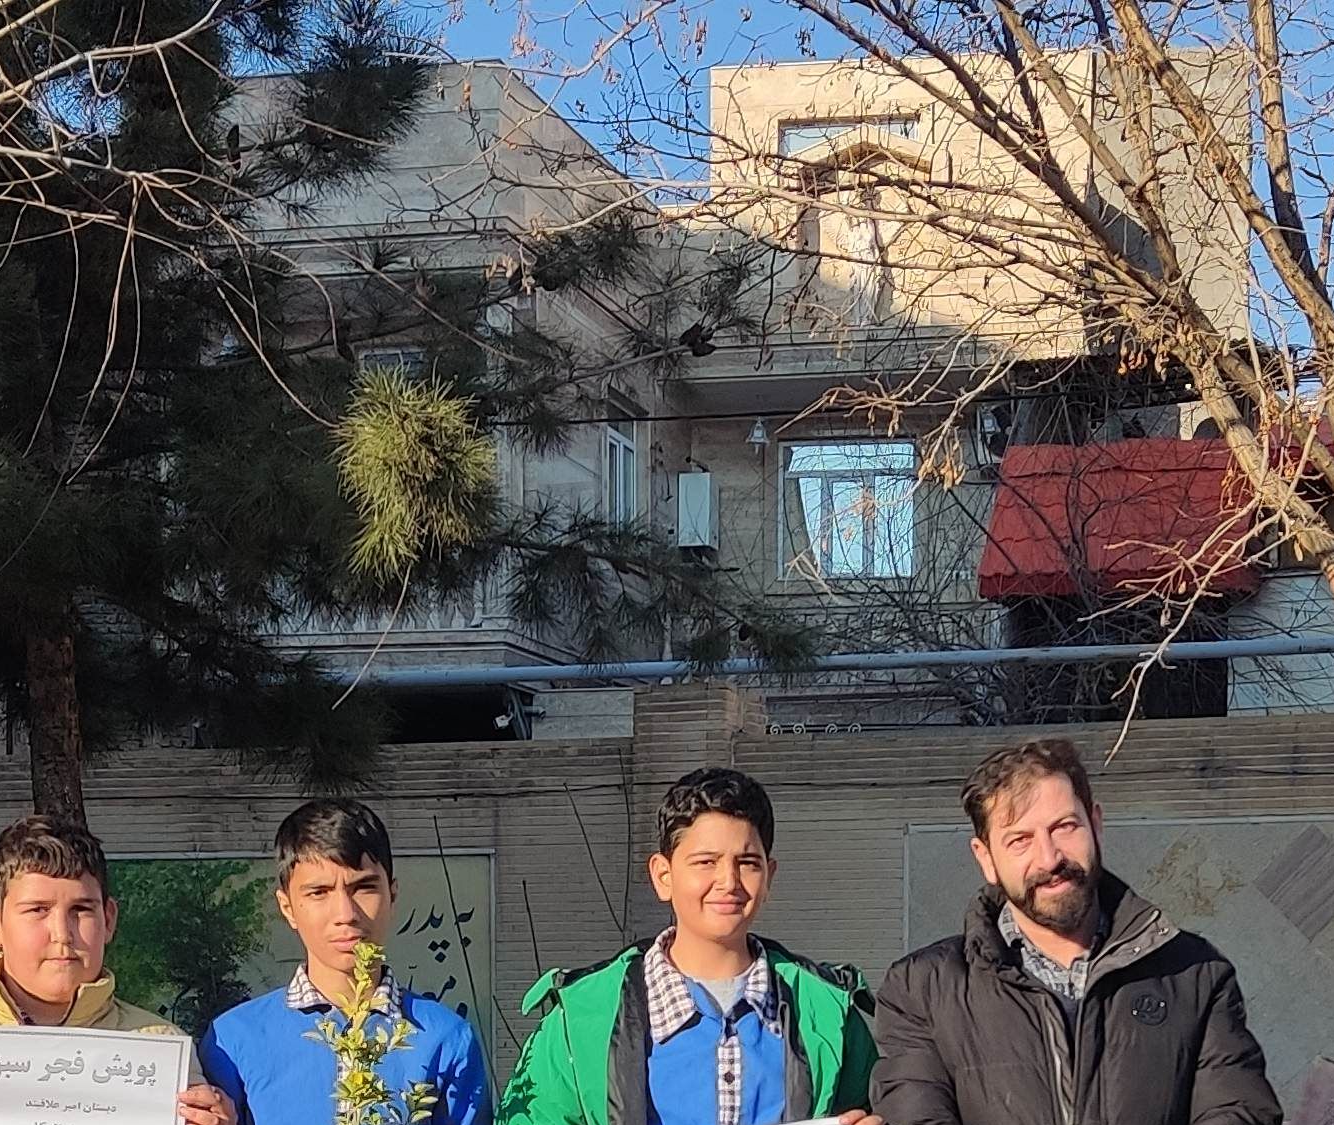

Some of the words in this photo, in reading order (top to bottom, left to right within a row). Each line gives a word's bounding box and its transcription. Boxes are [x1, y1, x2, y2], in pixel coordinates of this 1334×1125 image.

[395, 903, 451, 964] پدر
[36, 1049, 85, 1082] فجر
[91, 1053, 157, 1087] پویش
[82, 1101, 117, 1115] دبستان
